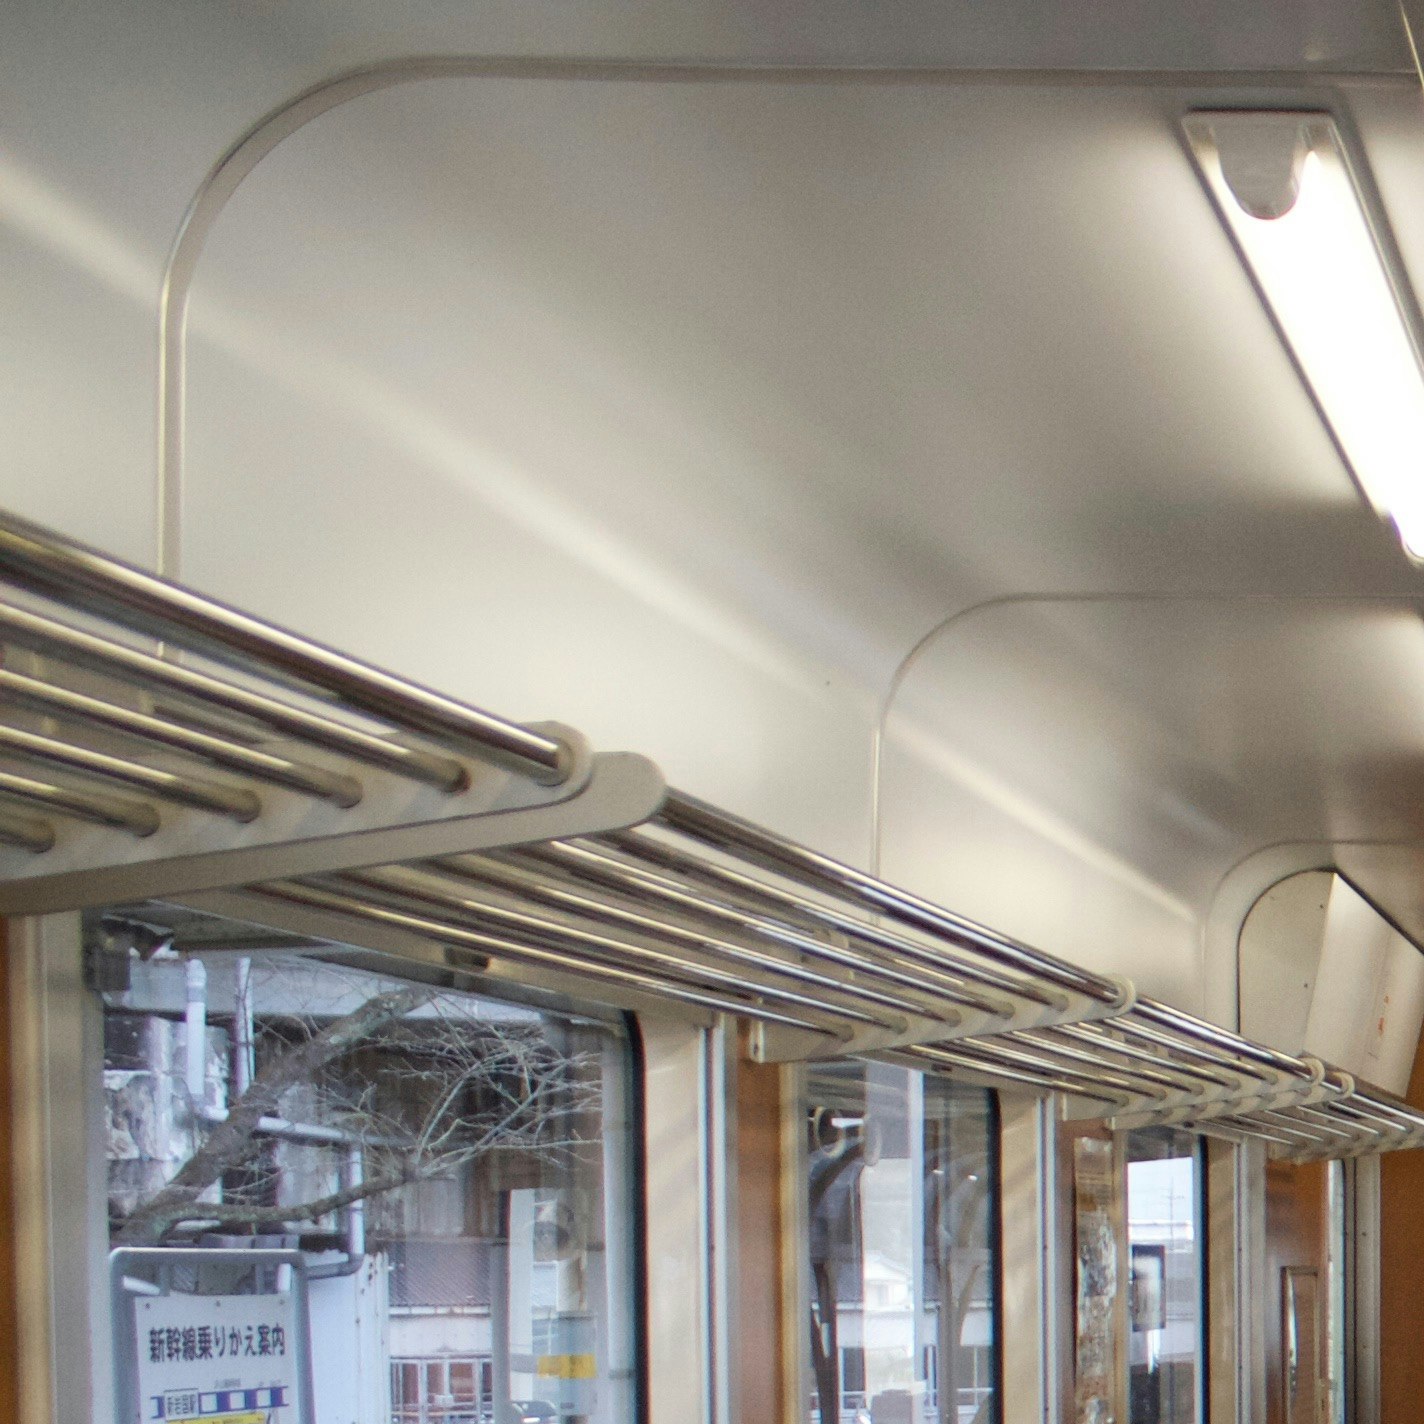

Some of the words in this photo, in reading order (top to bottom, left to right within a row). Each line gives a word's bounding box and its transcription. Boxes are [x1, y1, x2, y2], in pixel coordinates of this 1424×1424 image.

[149, 1322, 286, 1363] 新幹線乗りかえ案内
